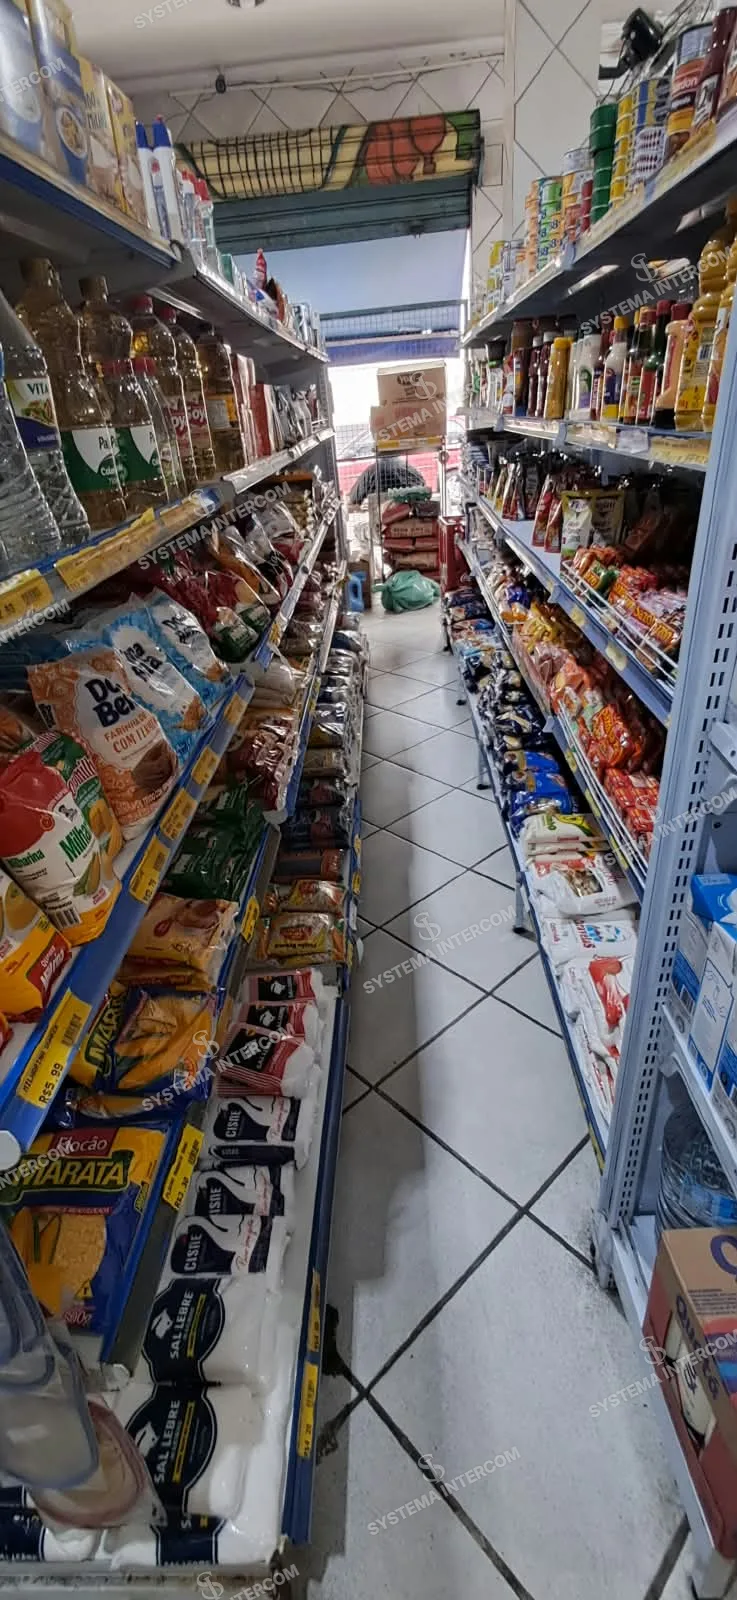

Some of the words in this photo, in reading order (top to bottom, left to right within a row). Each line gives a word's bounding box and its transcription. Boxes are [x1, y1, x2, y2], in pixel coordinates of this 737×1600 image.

[113, 733, 137, 754] COM
[209, 1186, 222, 1215] ISNE
[184, 1231, 202, 1272] CISNE
[176, 1289, 194, 1333] LEBRE
[170, 1333, 183, 1359] SAL
[153, 1446, 168, 1484] SAL
[163, 1400, 180, 1446] LEBRE
